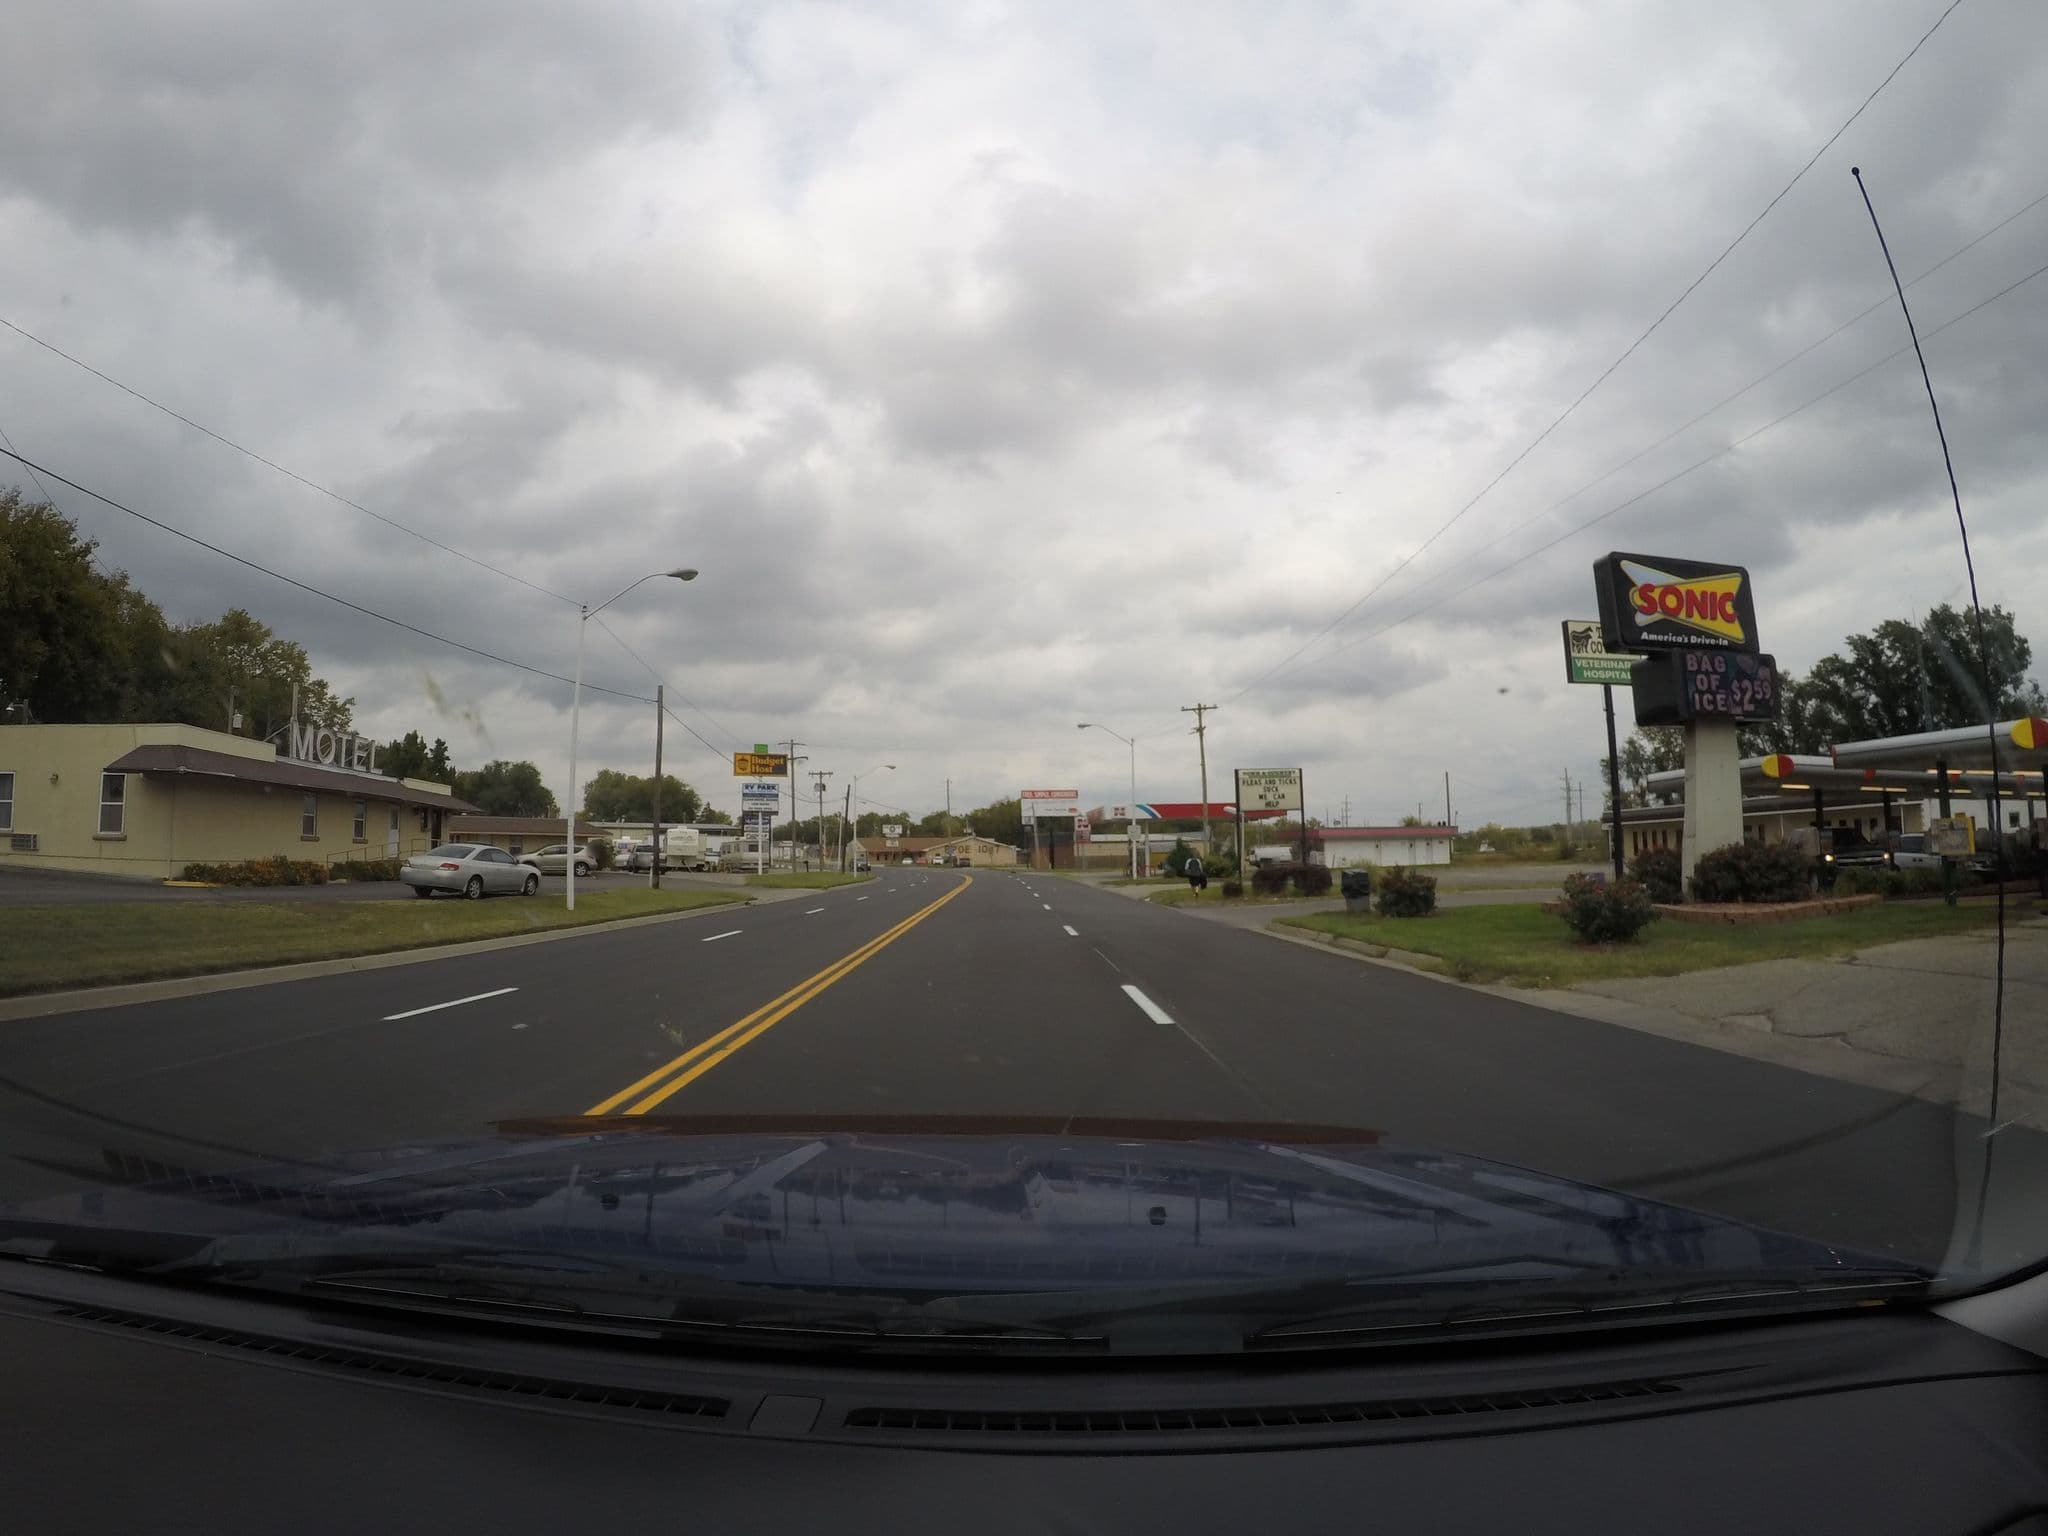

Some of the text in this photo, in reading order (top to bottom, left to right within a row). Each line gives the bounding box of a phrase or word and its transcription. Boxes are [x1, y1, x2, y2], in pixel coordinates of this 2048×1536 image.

[1638, 583, 1738, 625] SONIC
[1641, 632, 1729, 646] America's Drive-In
[1590, 641, 1603, 654] CO
[1575, 659, 1632, 669] VETERINAR
[1686, 654, 1726, 672] BAG
[1696, 674, 1720, 691] OF
[1694, 693, 1727, 711] ICE
[289, 721, 382, 775] MOTEL
[752, 755, 785, 766] Budget
[752, 765, 773, 773] Host
